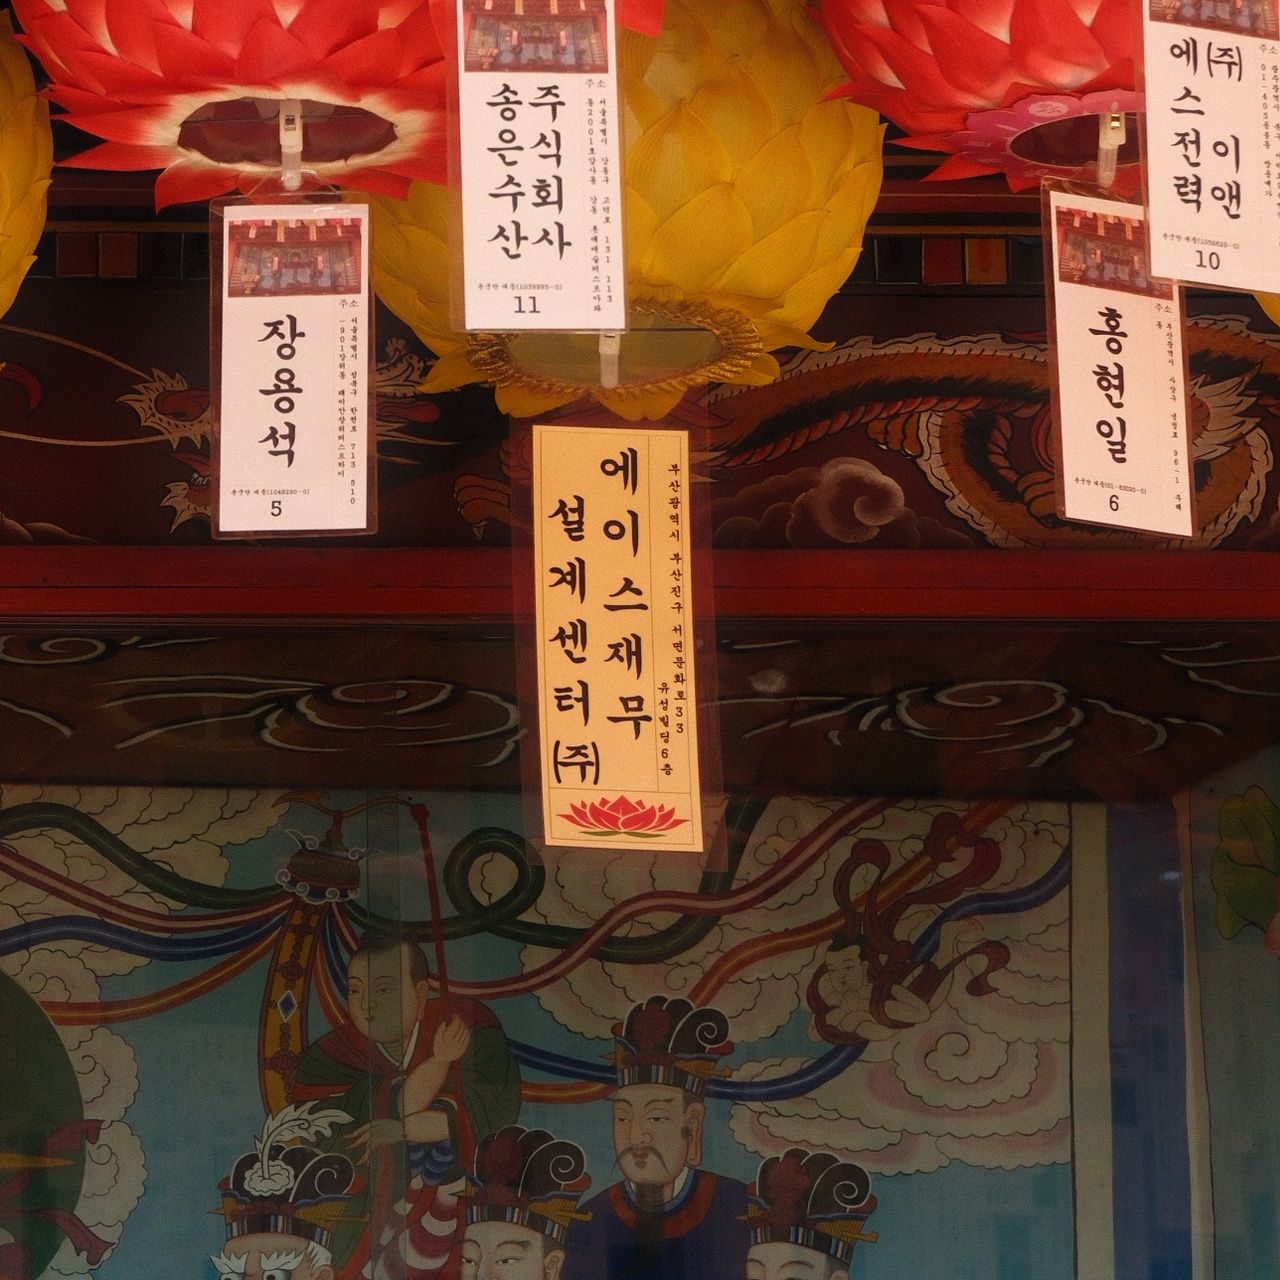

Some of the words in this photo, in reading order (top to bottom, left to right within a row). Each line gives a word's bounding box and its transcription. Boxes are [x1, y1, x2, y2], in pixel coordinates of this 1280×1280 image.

[1207, 41, 1243, 83] (주)
[1170, 36, 1206, 215] 에스전력
[485, 82, 529, 261] 송은수산
[528, 84, 573, 261] 주식회사
[1210, 134, 1242, 221] 이앤
[1195, 249, 1221, 270] 10
[338, 298, 359, 308] 주소
[513, 295, 542, 315] 11
[257, 313, 306, 469] 장용석
[1087, 306, 1128, 464] 홍현일
[349, 442, 357, 469] 713
[349, 479, 357, 506] 510
[269, 500, 283, 517] 5
[667, 463, 681, 543] 부산광역시
[1108, 494, 1120, 512] 6
[600, 447, 653, 740] 에이스재무
[670, 552, 683, 615] 부산진구
[548, 494, 600, 786] 설계센터(주)
[672, 624, 687, 735] 서면문화로33
[657, 682, 674, 777] 유성빌딩6층
